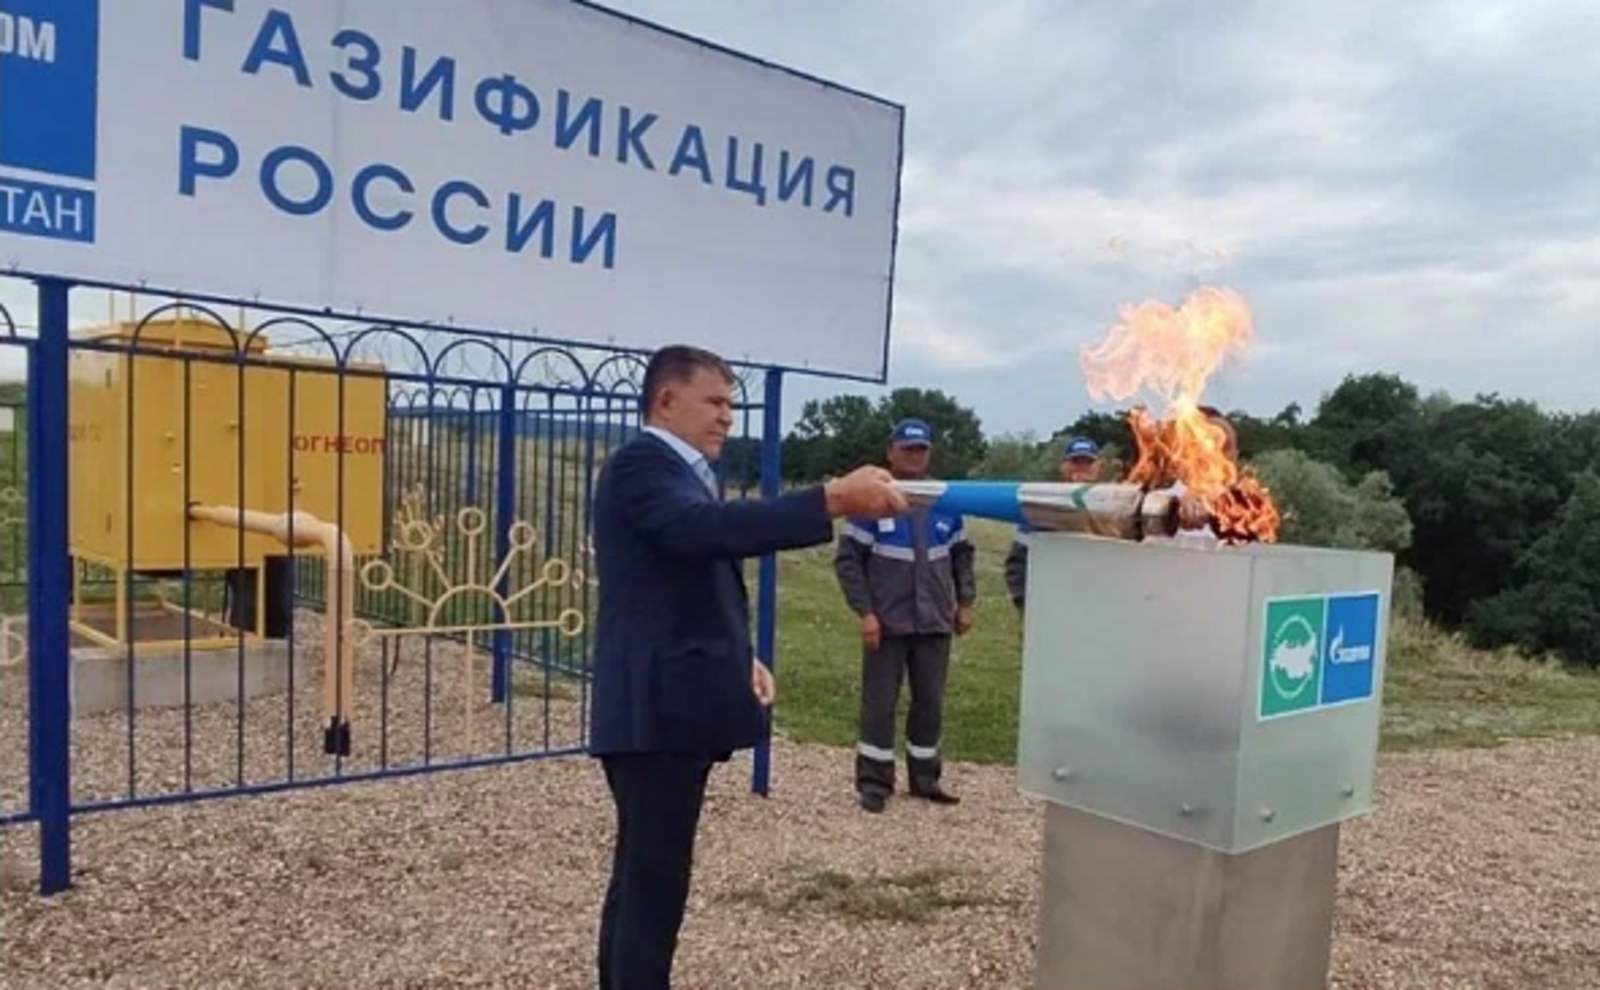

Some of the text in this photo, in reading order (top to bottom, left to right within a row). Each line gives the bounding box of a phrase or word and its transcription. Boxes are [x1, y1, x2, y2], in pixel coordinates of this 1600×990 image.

[183, 0, 856, 217] ГАЗИФИКАЦИЯ
[0, 185, 82, 233] ТАН
[178, 124, 617, 270] РОССИИ
